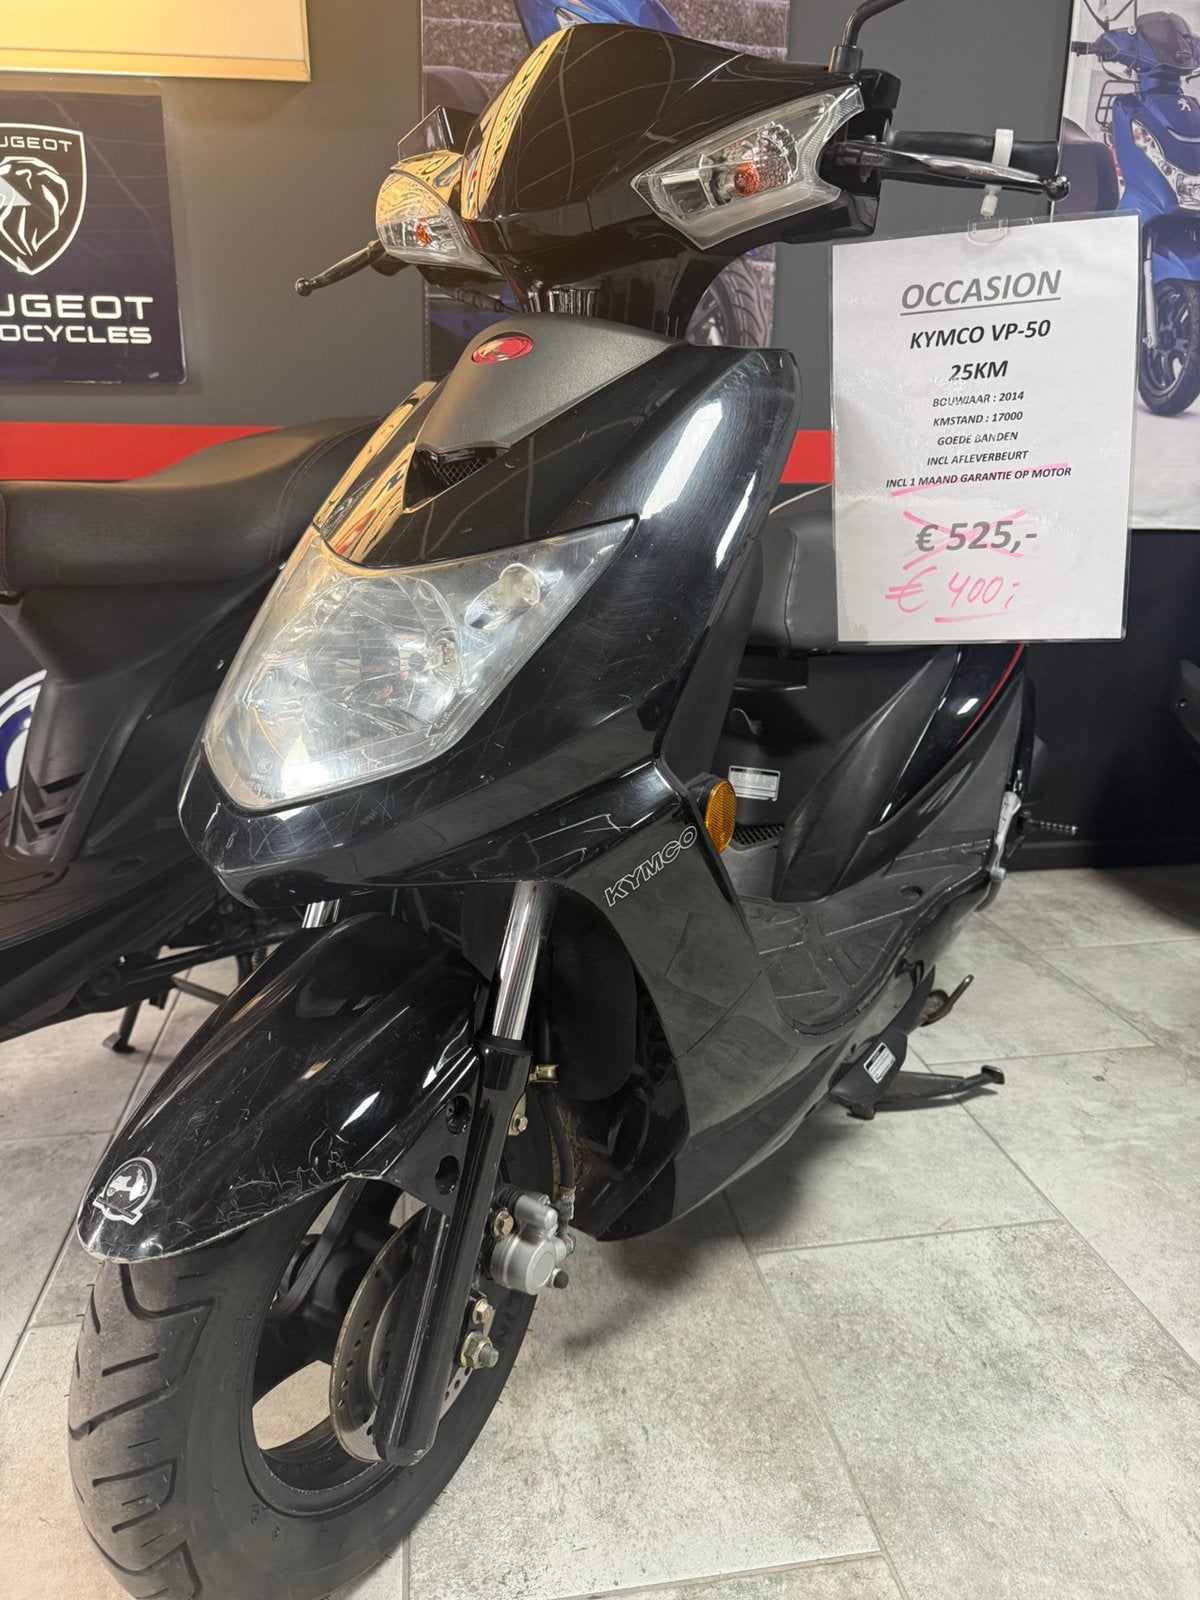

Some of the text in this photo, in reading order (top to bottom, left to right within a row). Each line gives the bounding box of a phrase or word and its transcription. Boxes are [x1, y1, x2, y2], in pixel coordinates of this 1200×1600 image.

[902, 270, 1062, 309] OCCASION
[910, 319, 1051, 349] KYMCO VP-50
[949, 360, 1008, 381] 25KM
[932, 394, 991, 407] BOUWJAAR
[999, 391, 1025, 402] 2014
[933, 414, 984, 426] KMSTAND
[991, 411, 1023, 423] 17000
[937, 431, 1019, 446] GOEDE BANDEN
[927, 450, 1029, 466] INCL AFLEVERBEURT
[886, 467, 1072, 488] INCL 1 MAAND GARANTIE OP MOTOR
[915, 519, 1038, 554] € 525,-
[884, 566, 938, 613] €
[604, 825, 698, 907] KYMCO
